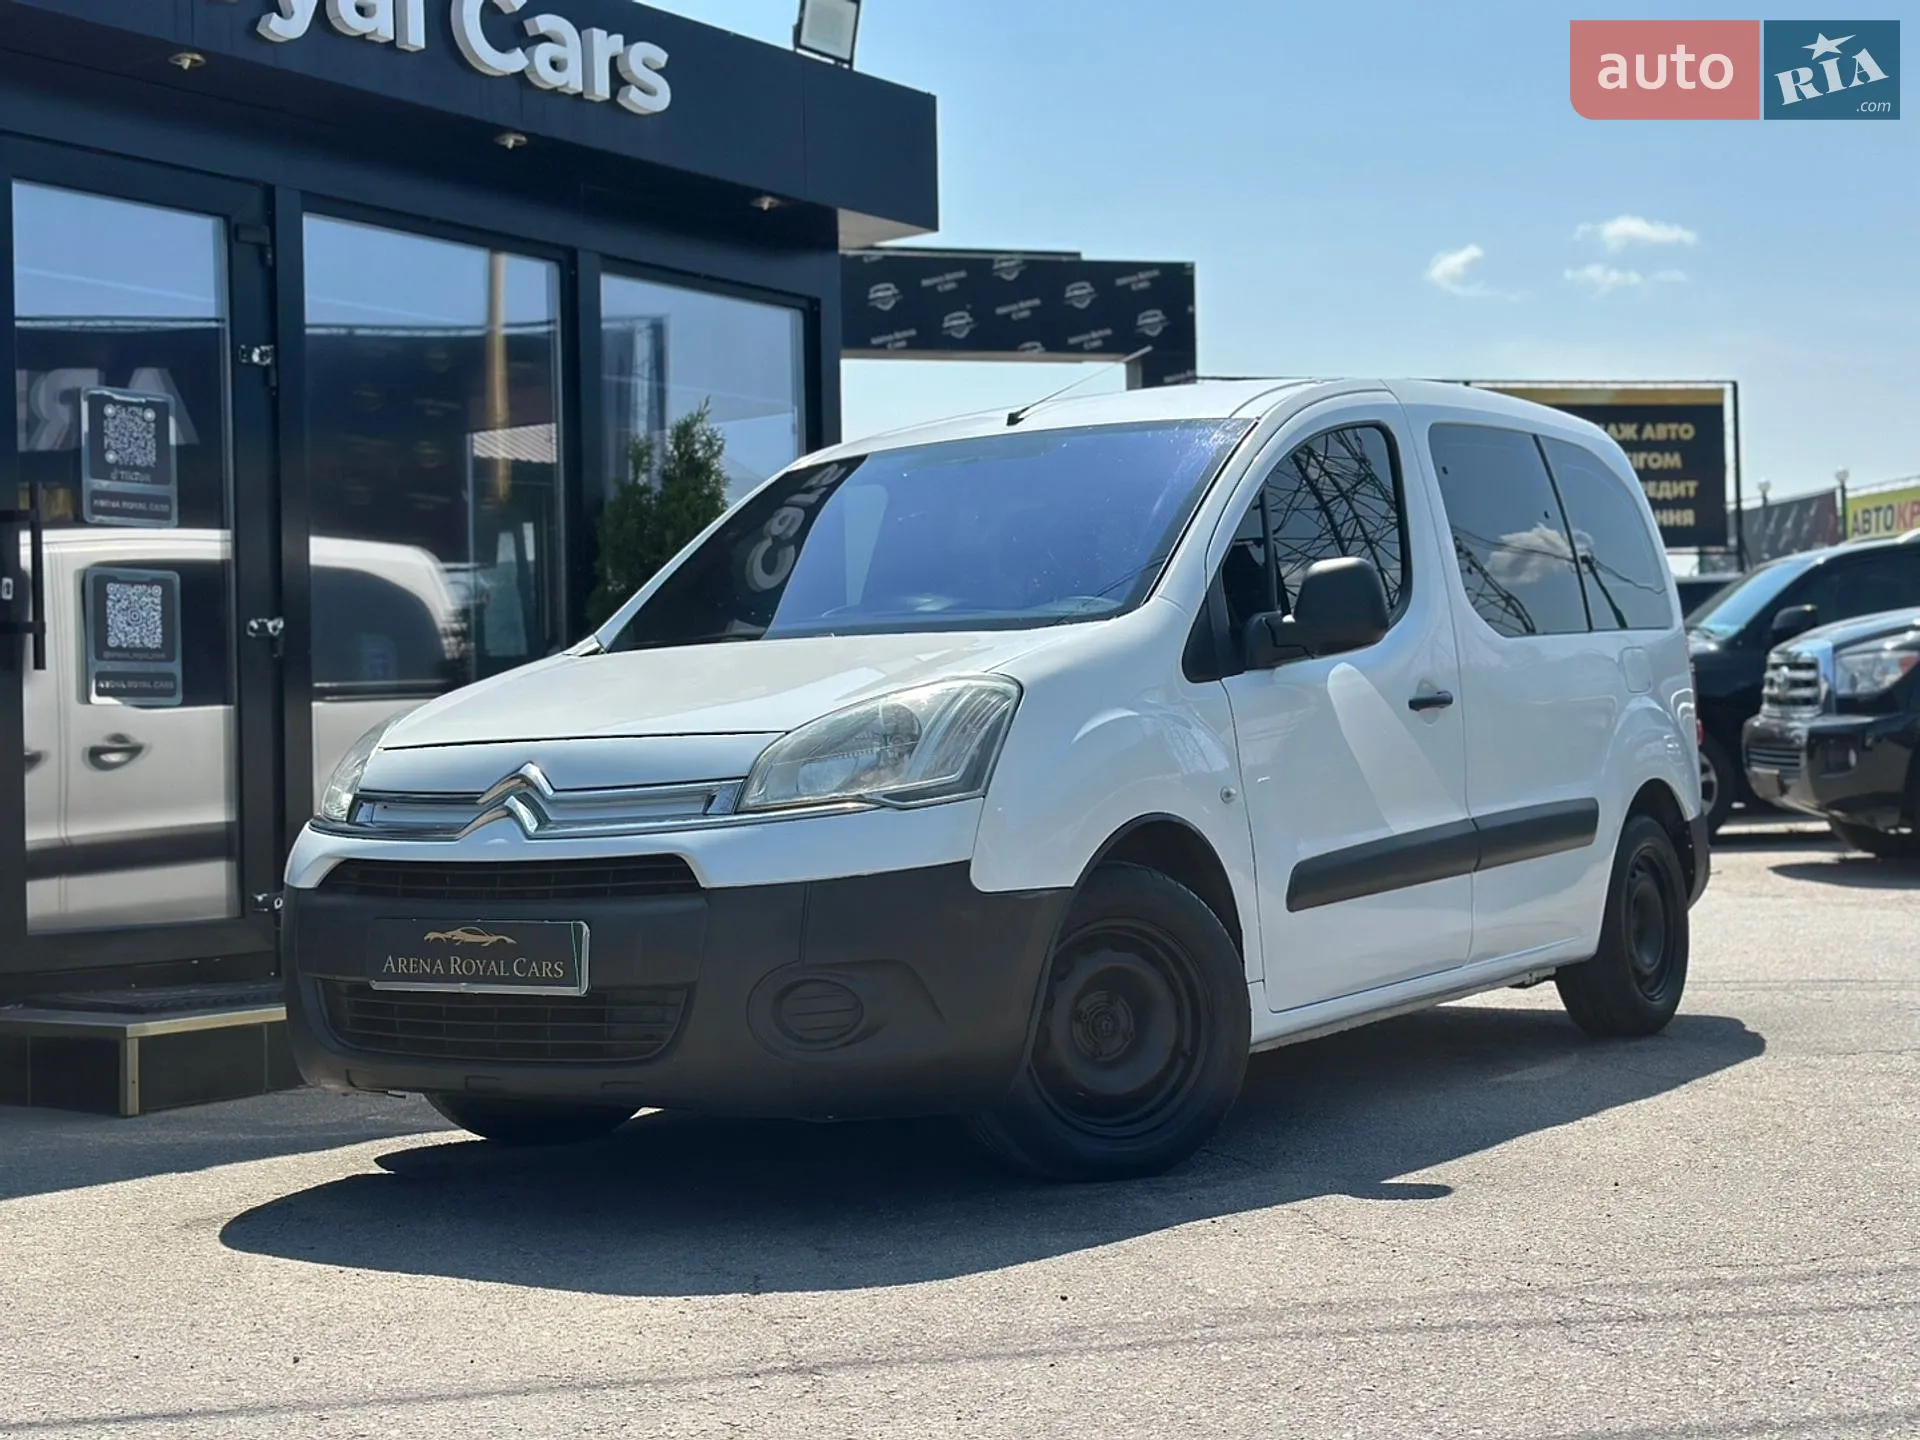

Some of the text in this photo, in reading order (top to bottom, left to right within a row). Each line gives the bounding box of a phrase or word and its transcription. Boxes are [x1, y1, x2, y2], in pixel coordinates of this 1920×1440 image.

[451, 0, 671, 115] Cars
[1600, 423, 1696, 441] АЖ АВТО
[1627, 452, 1682, 469] ІГОМ
[382, 955, 565, 979] ARENA ROYAL CARS
